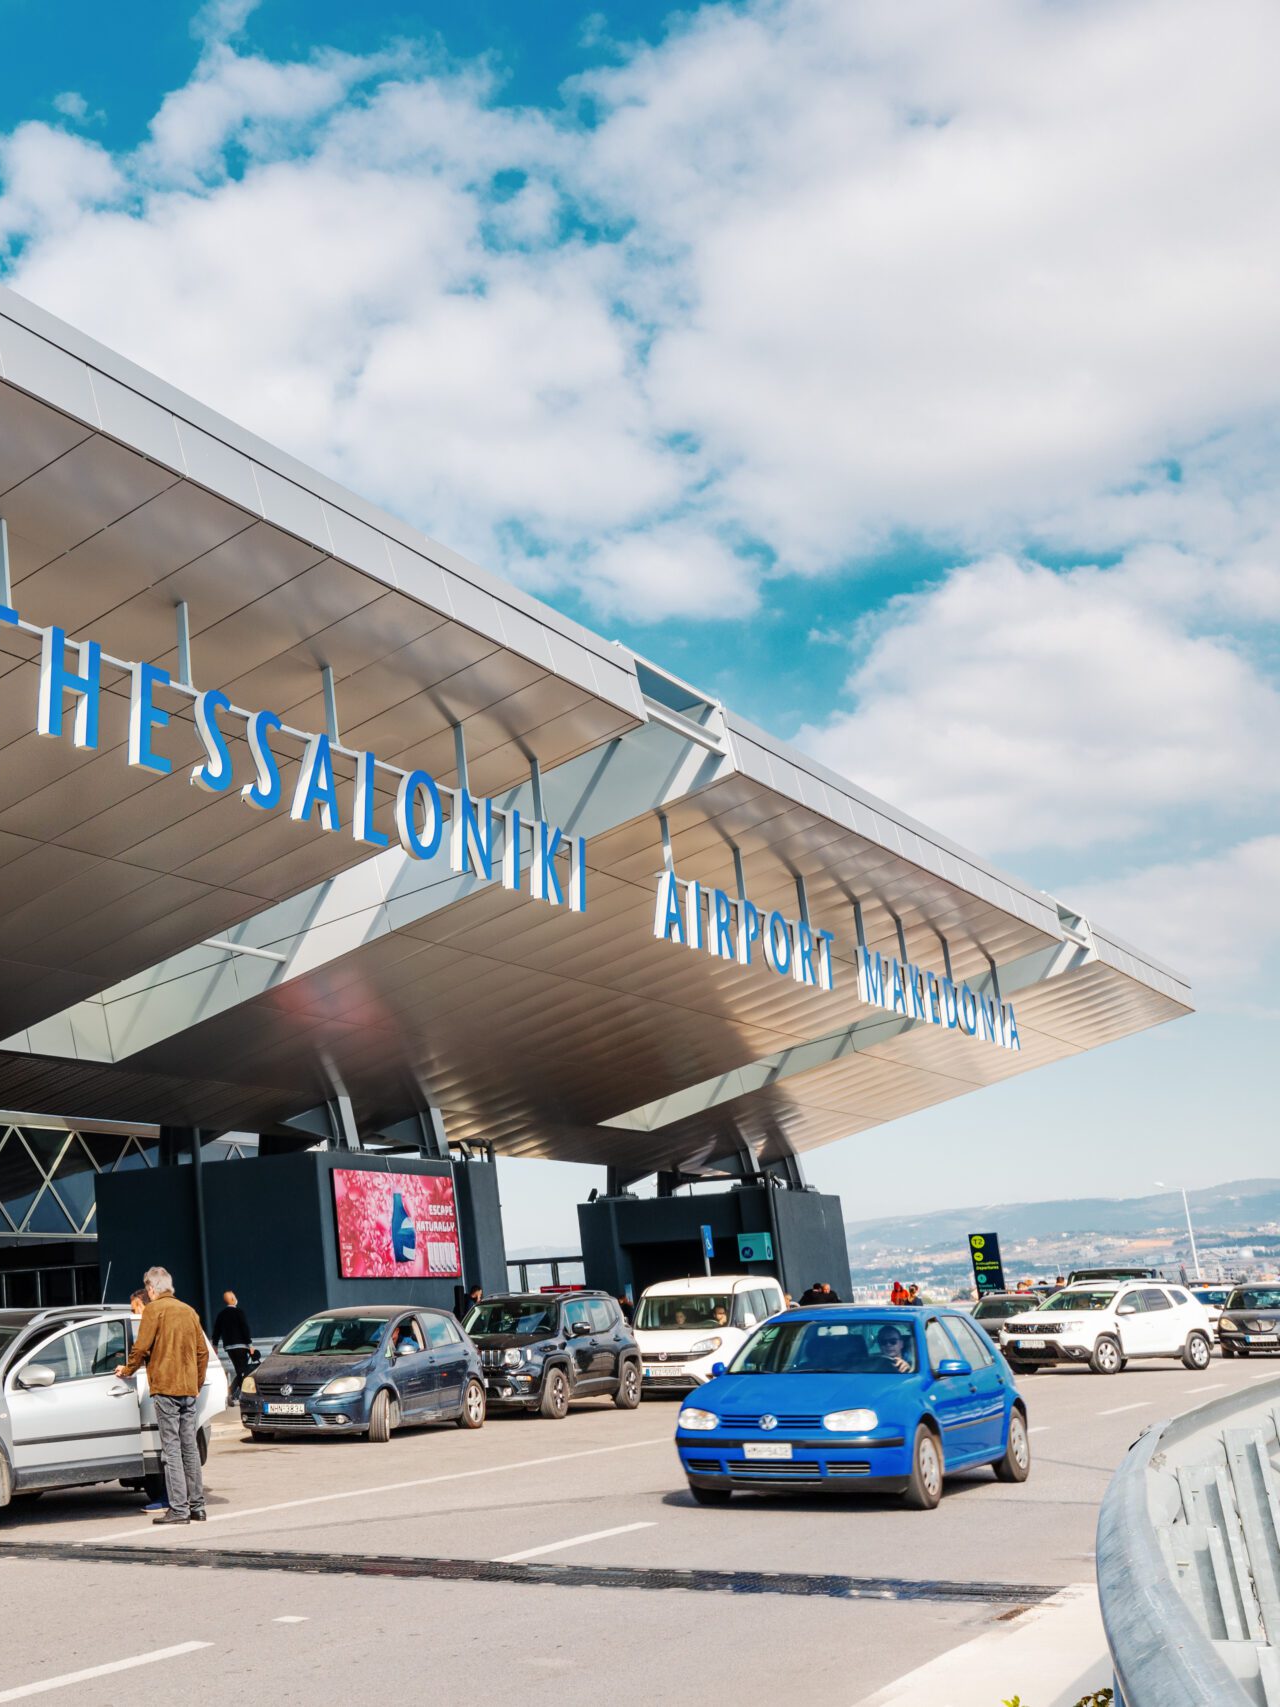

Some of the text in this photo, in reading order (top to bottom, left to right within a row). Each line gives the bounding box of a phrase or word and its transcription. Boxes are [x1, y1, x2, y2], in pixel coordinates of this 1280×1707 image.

[654, 871, 1021, 1051] AIRPORT MAKEDONIA
[429, 1204, 453, 1216] ESCAPE
[416, 1221, 455, 1232] NATURALLY
